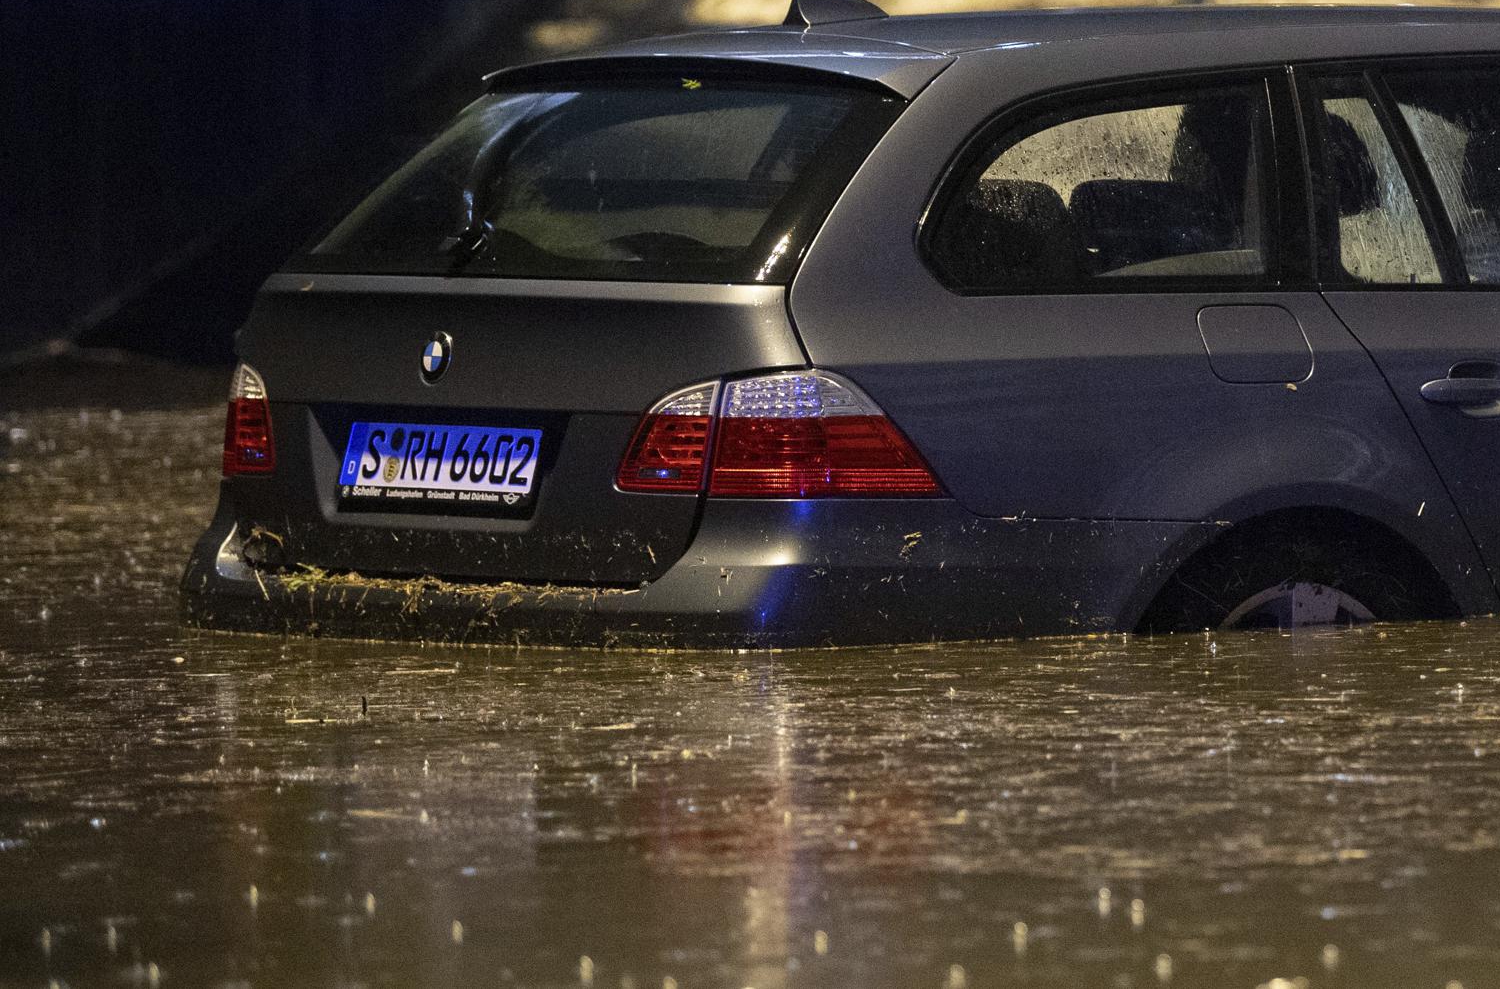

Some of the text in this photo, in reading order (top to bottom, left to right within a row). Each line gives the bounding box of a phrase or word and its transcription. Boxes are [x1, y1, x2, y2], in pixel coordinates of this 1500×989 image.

[362, 430, 386, 479] S
[400, 430, 449, 481] RH
[450, 433, 536, 486] 6602
[427, 490, 456, 500] Grünstadt
[458, 492, 471, 501] Bad
[471, 492, 499, 502] Dürkheim
